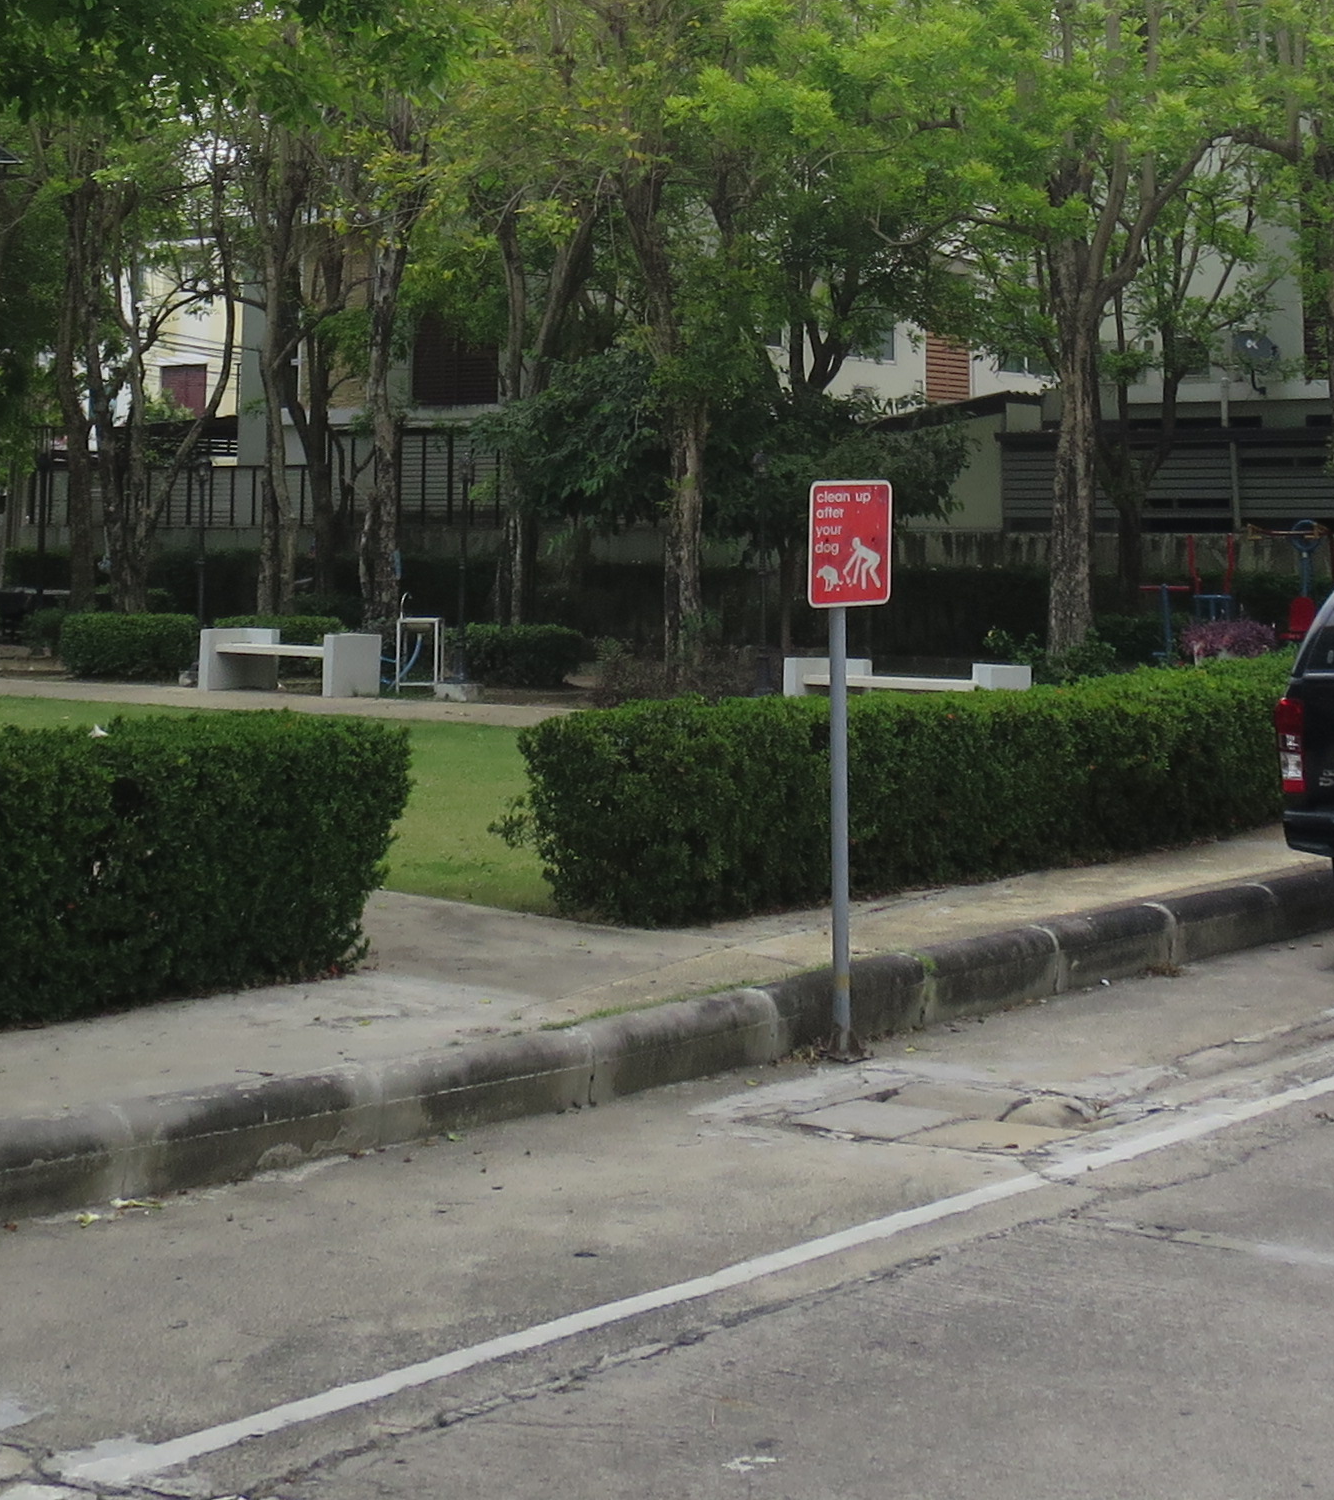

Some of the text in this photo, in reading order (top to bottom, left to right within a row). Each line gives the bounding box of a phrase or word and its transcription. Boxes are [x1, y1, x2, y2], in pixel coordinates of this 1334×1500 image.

[816, 491, 871, 504] clean up
[816, 507, 844, 519] after
[816, 525, 842, 537] your
[815, 542, 839, 555] dog
